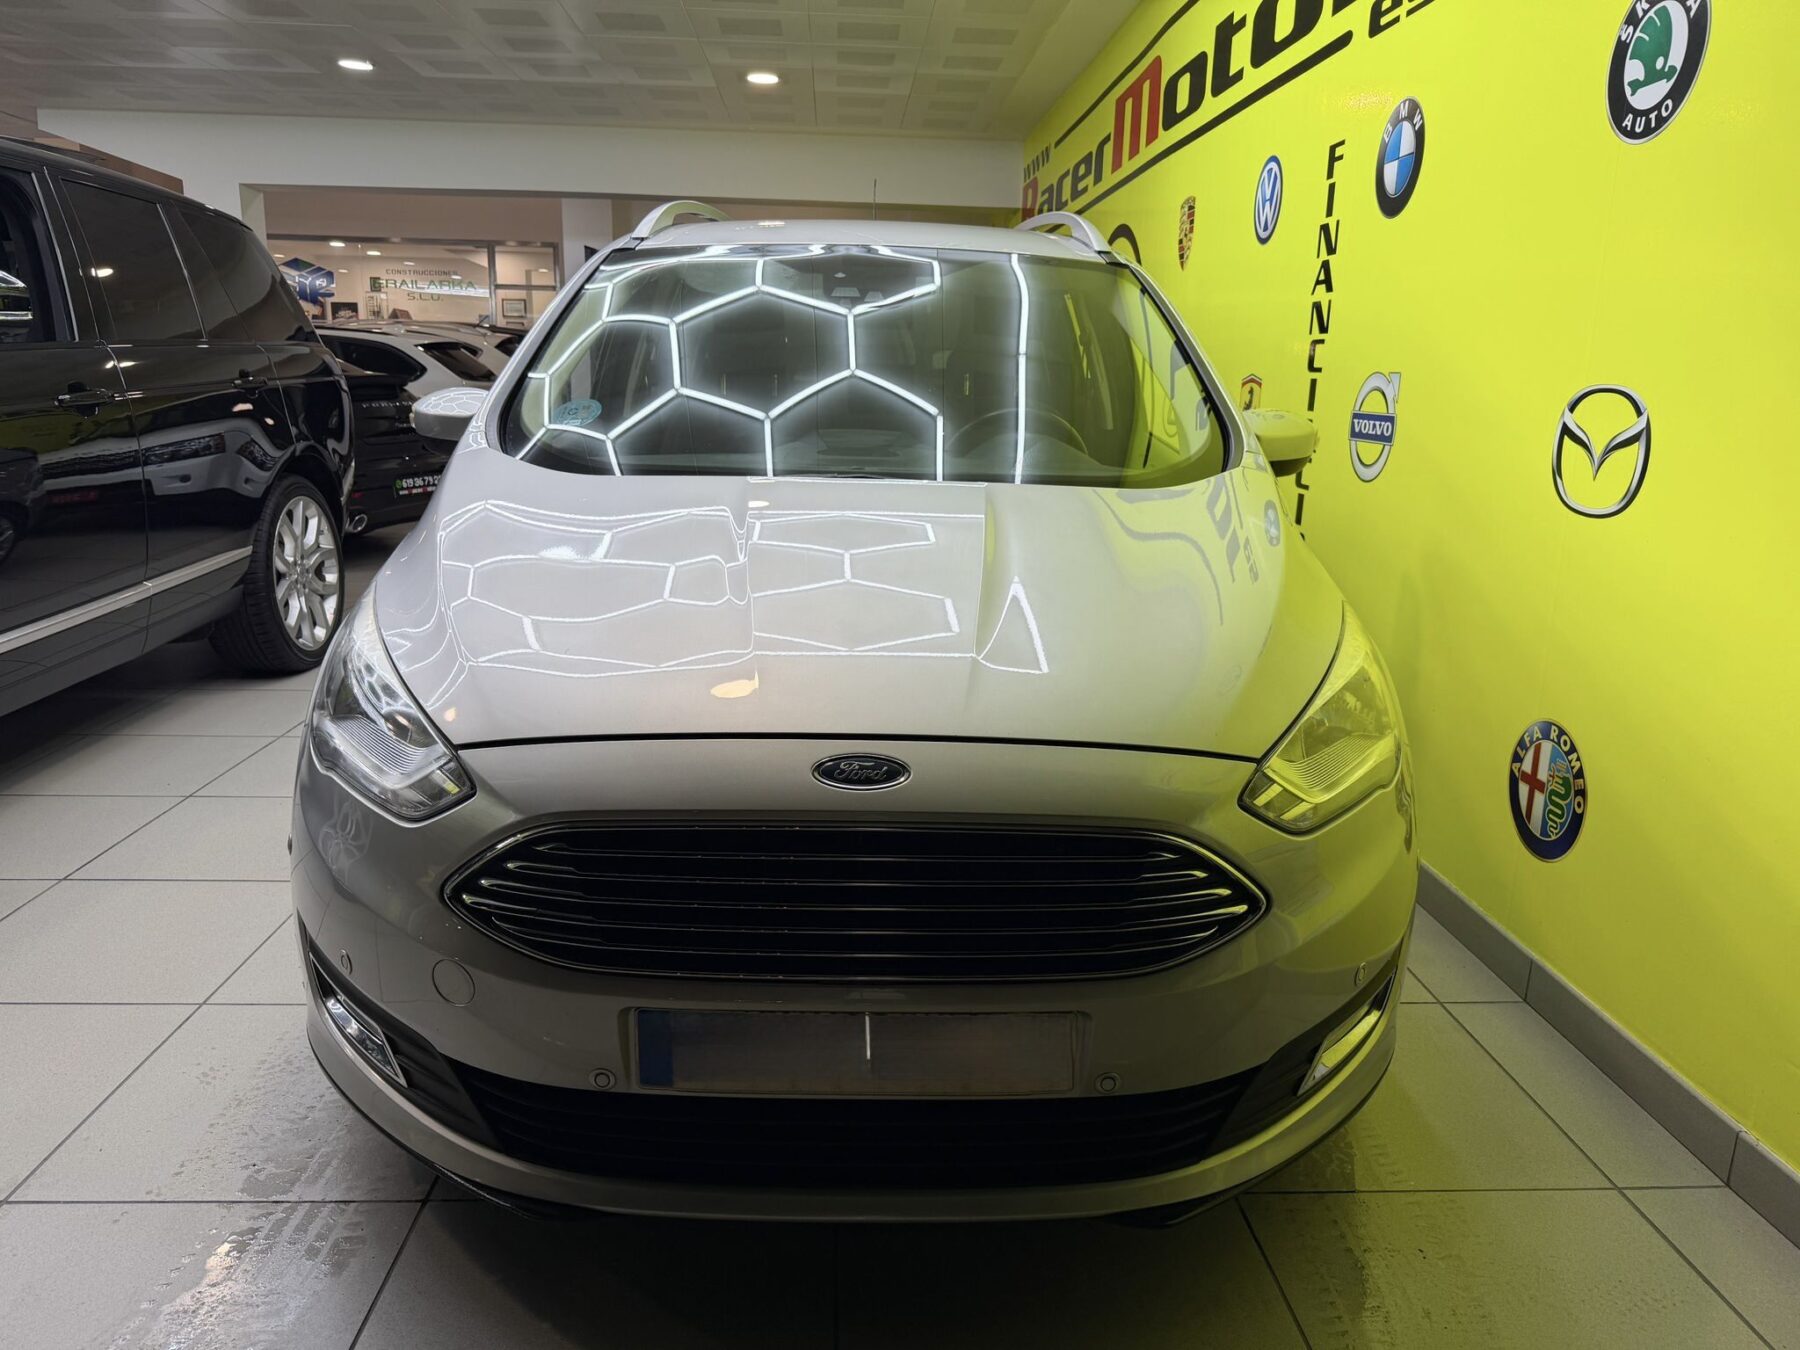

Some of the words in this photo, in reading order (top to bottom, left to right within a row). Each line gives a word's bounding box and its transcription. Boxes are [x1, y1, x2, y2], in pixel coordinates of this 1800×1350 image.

[1383, 100, 1423, 143] BMW
[1622, 99, 1674, 133] AUTO
[1353, 418, 1393, 437] VOLVO
[834, 760, 888, 781] Ford
[1512, 726, 1542, 778] ALFA
[1550, 725, 1584, 814] ROMEO
